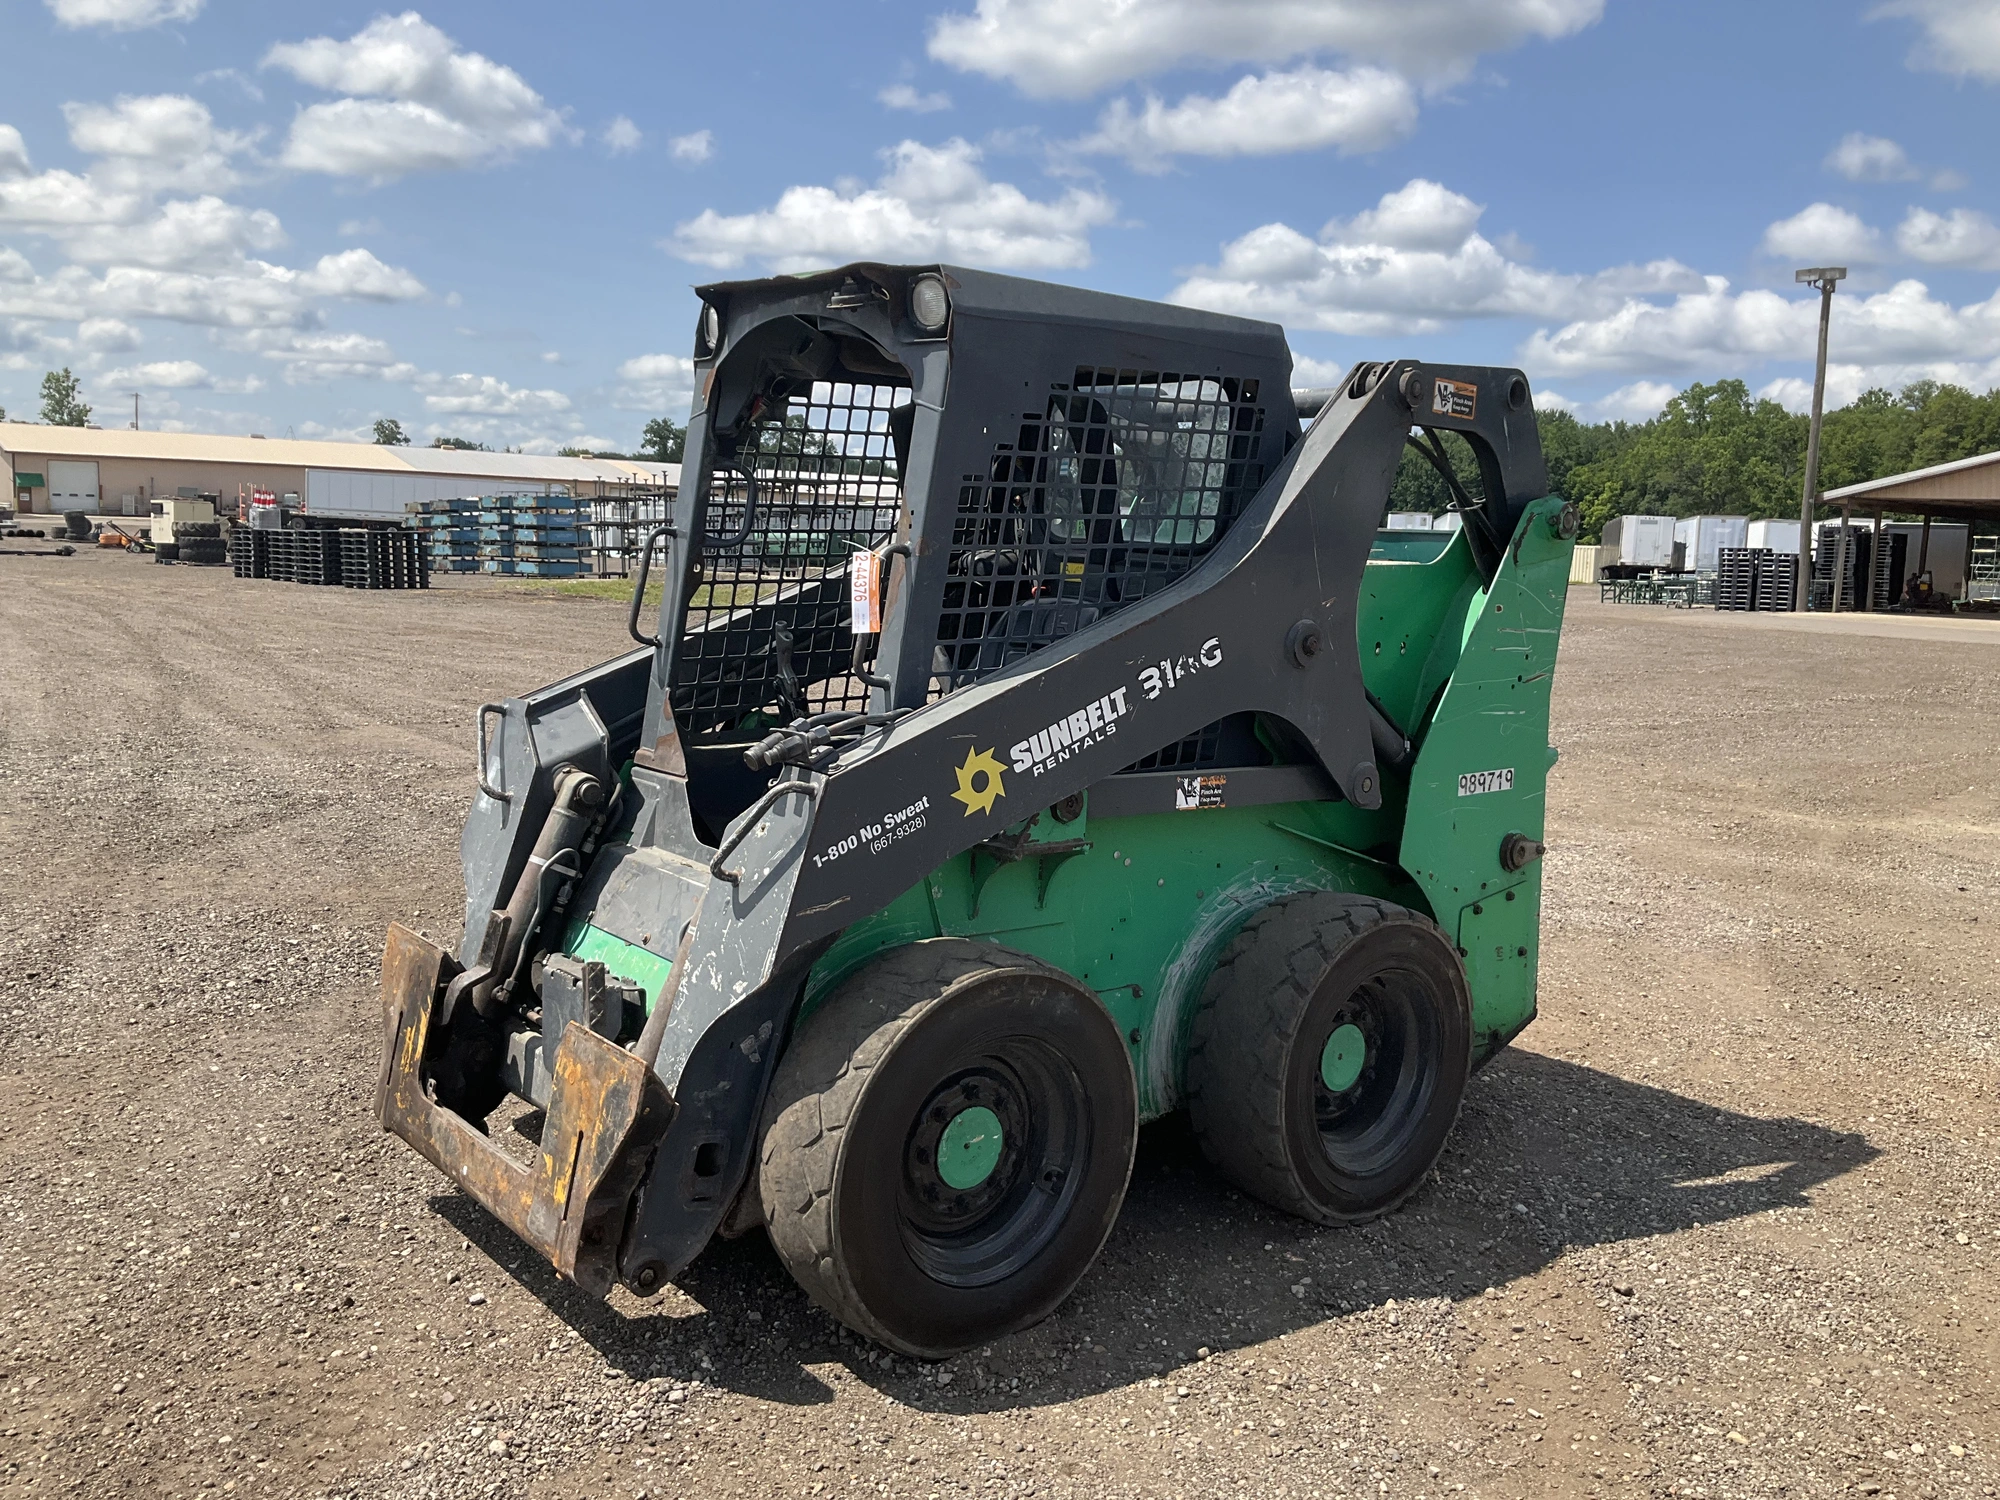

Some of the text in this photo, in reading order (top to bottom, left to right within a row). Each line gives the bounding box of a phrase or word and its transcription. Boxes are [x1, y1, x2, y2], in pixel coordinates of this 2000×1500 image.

[854, 555, 869, 602] 2-44376
[1009, 686, 1127, 773] SUNBELT
[1032, 722, 1117, 777] RENTALS
[1459, 769, 1513, 795] 989719
[812, 795, 930, 868] 1-800 No Sweat
[870, 813, 926, 855] (667-9328)
